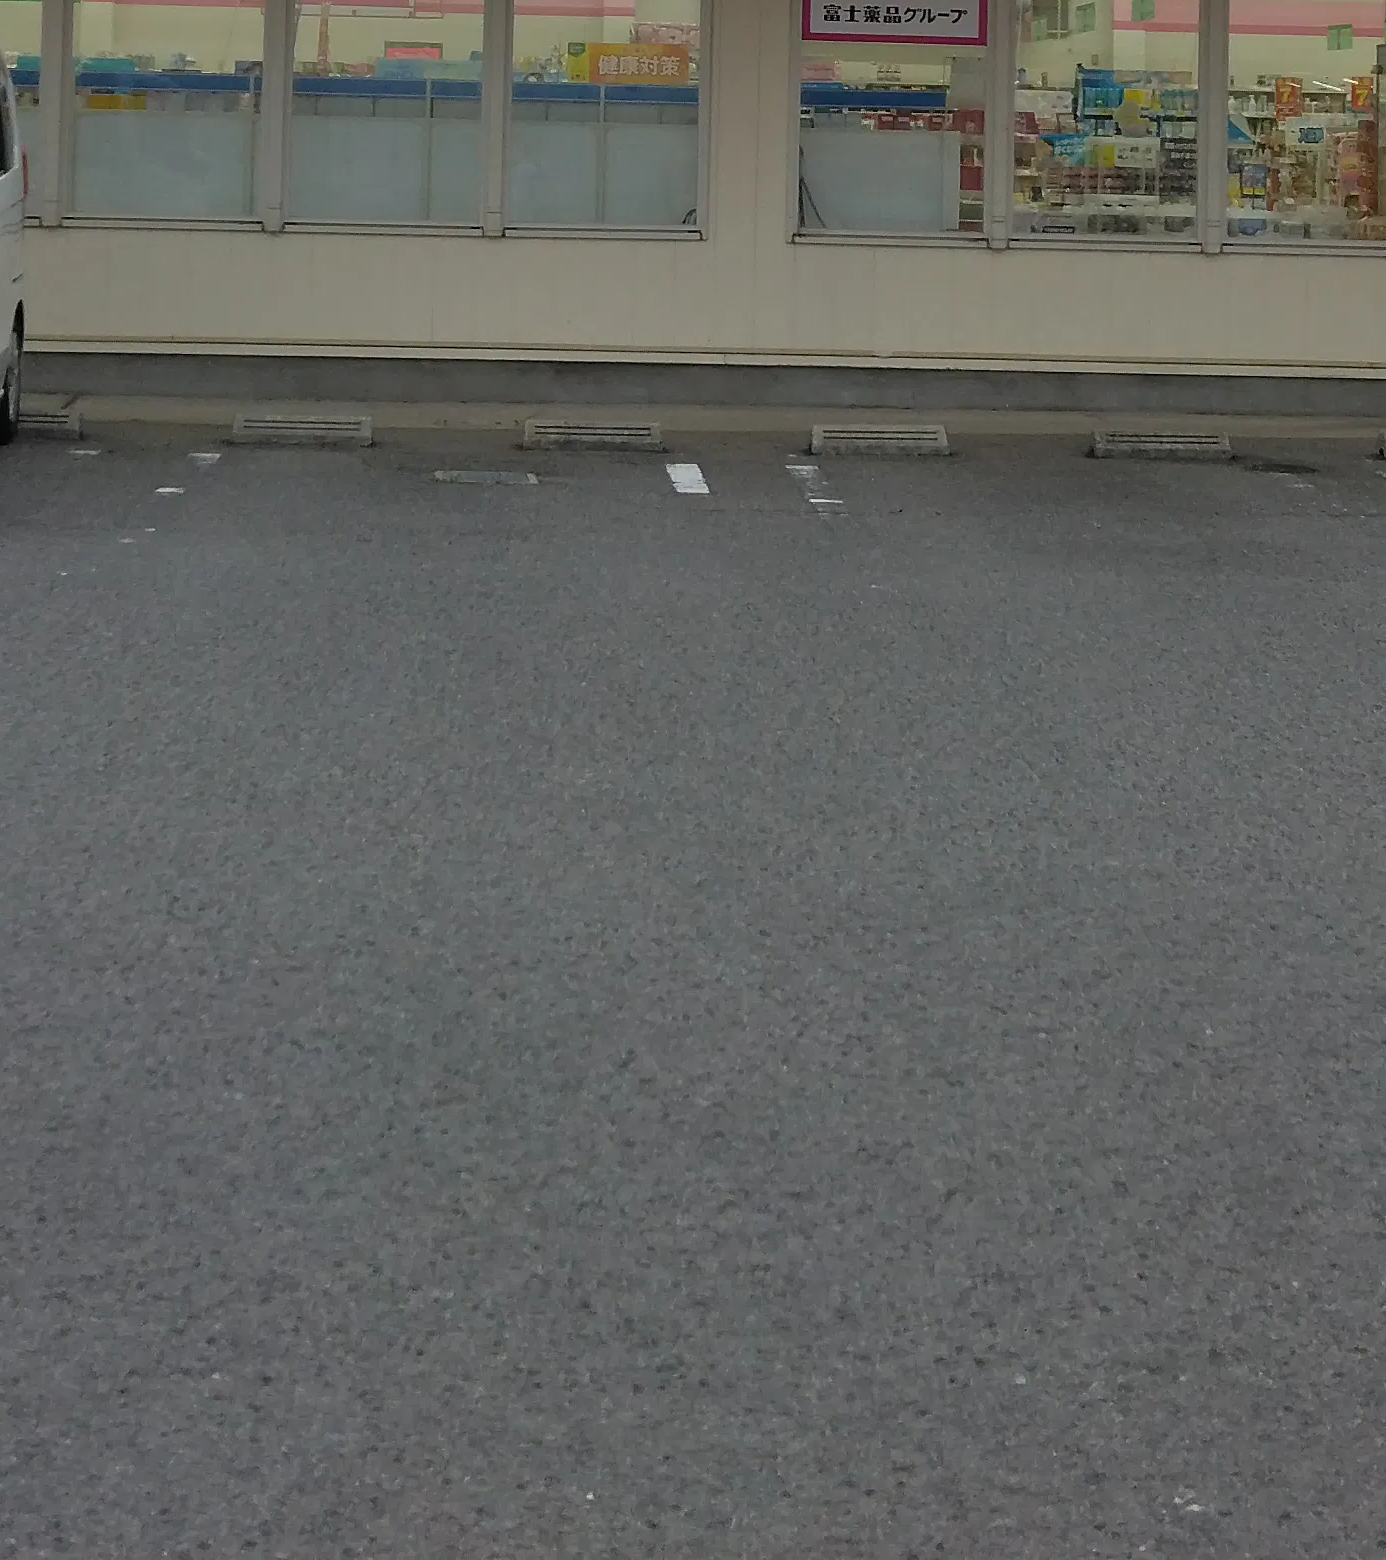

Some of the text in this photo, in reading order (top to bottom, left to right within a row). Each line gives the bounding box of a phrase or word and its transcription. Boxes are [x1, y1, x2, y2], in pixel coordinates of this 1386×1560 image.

[823, 3, 968, 24] 富士薬品グループ
[598, 54, 680, 76] 健康対策
